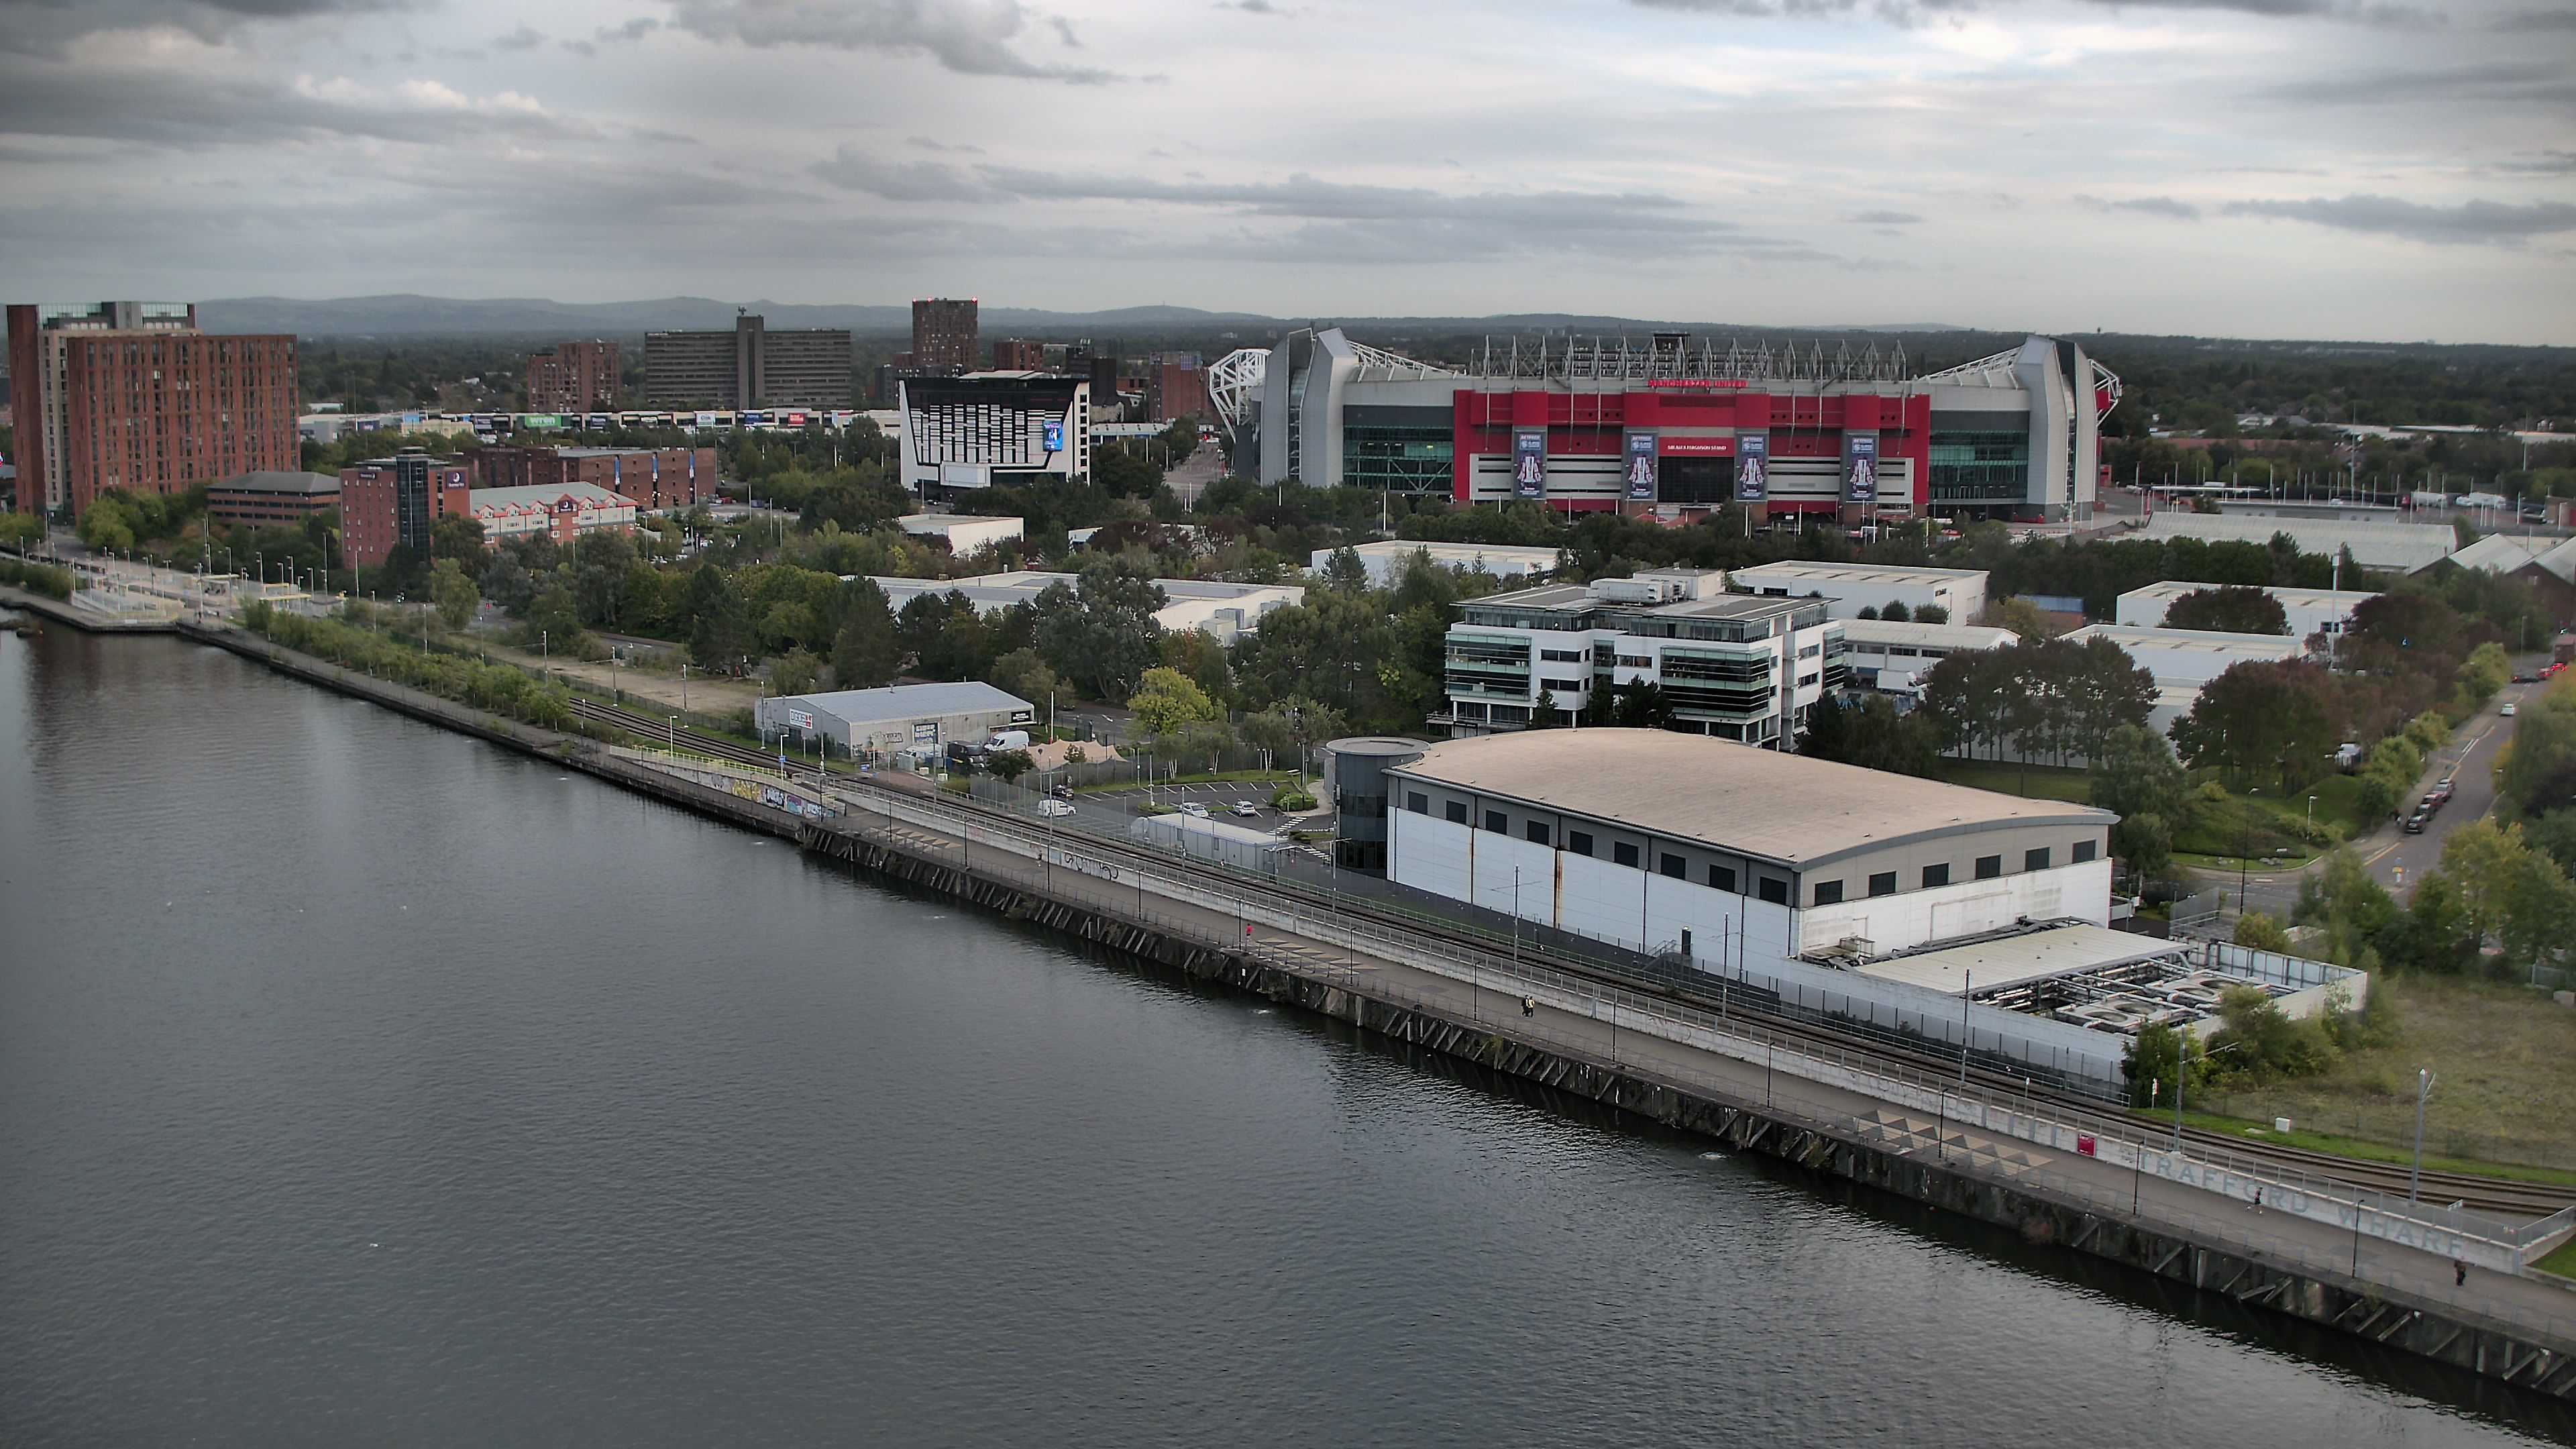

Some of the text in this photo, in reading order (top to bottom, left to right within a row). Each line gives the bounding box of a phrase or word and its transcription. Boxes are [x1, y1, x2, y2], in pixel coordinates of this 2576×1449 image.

[530, 415, 555, 425] wren
[2138, 1152, 2467, 1257] TRAFFORD WHARF
